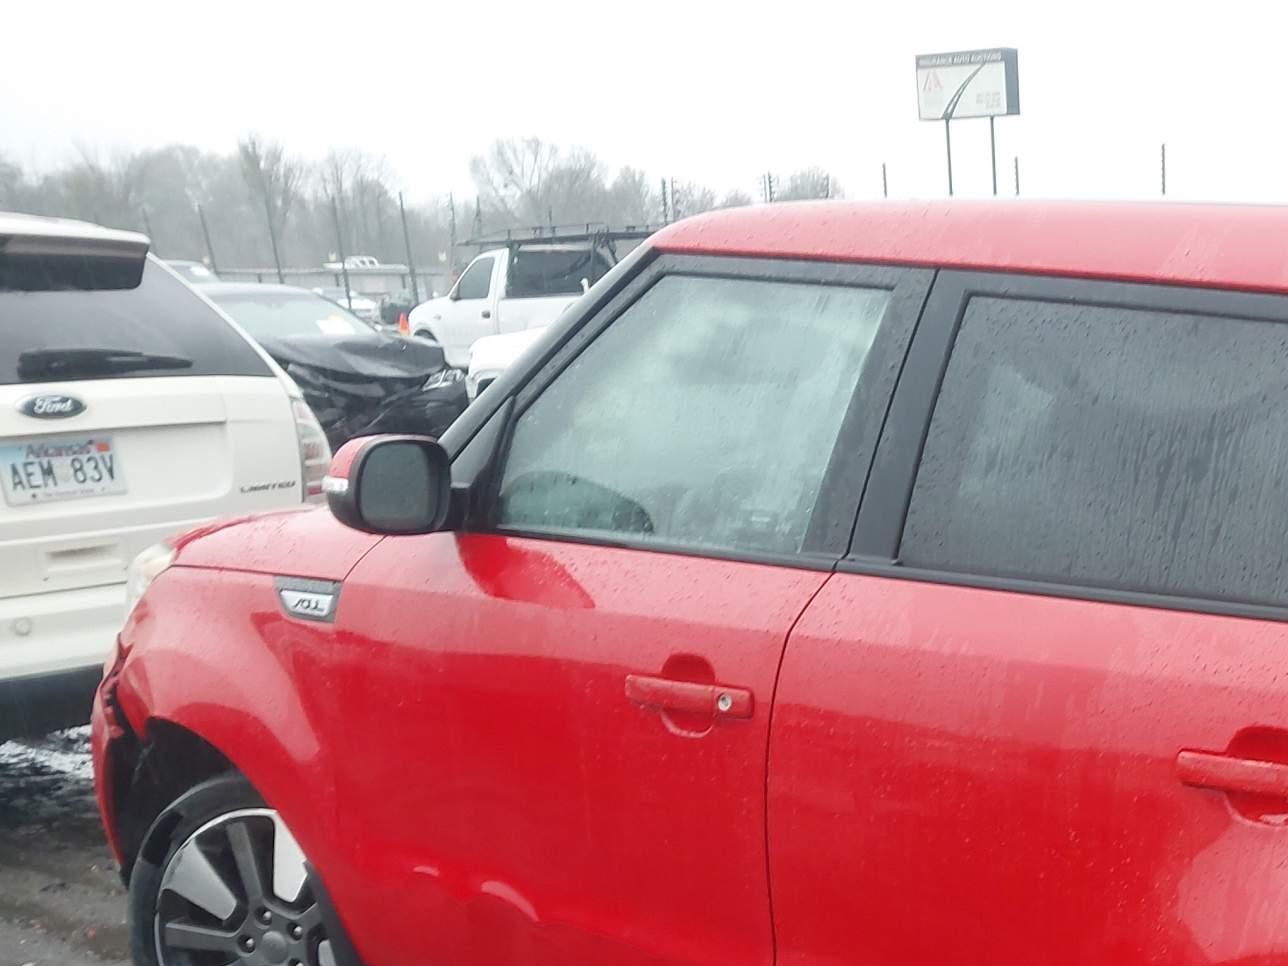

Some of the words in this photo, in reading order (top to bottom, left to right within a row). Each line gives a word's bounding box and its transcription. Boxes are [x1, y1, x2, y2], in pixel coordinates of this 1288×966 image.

[33, 397, 74, 414] Ford
[10, 459, 58, 491] AEM
[70, 454, 115, 484] 83V
